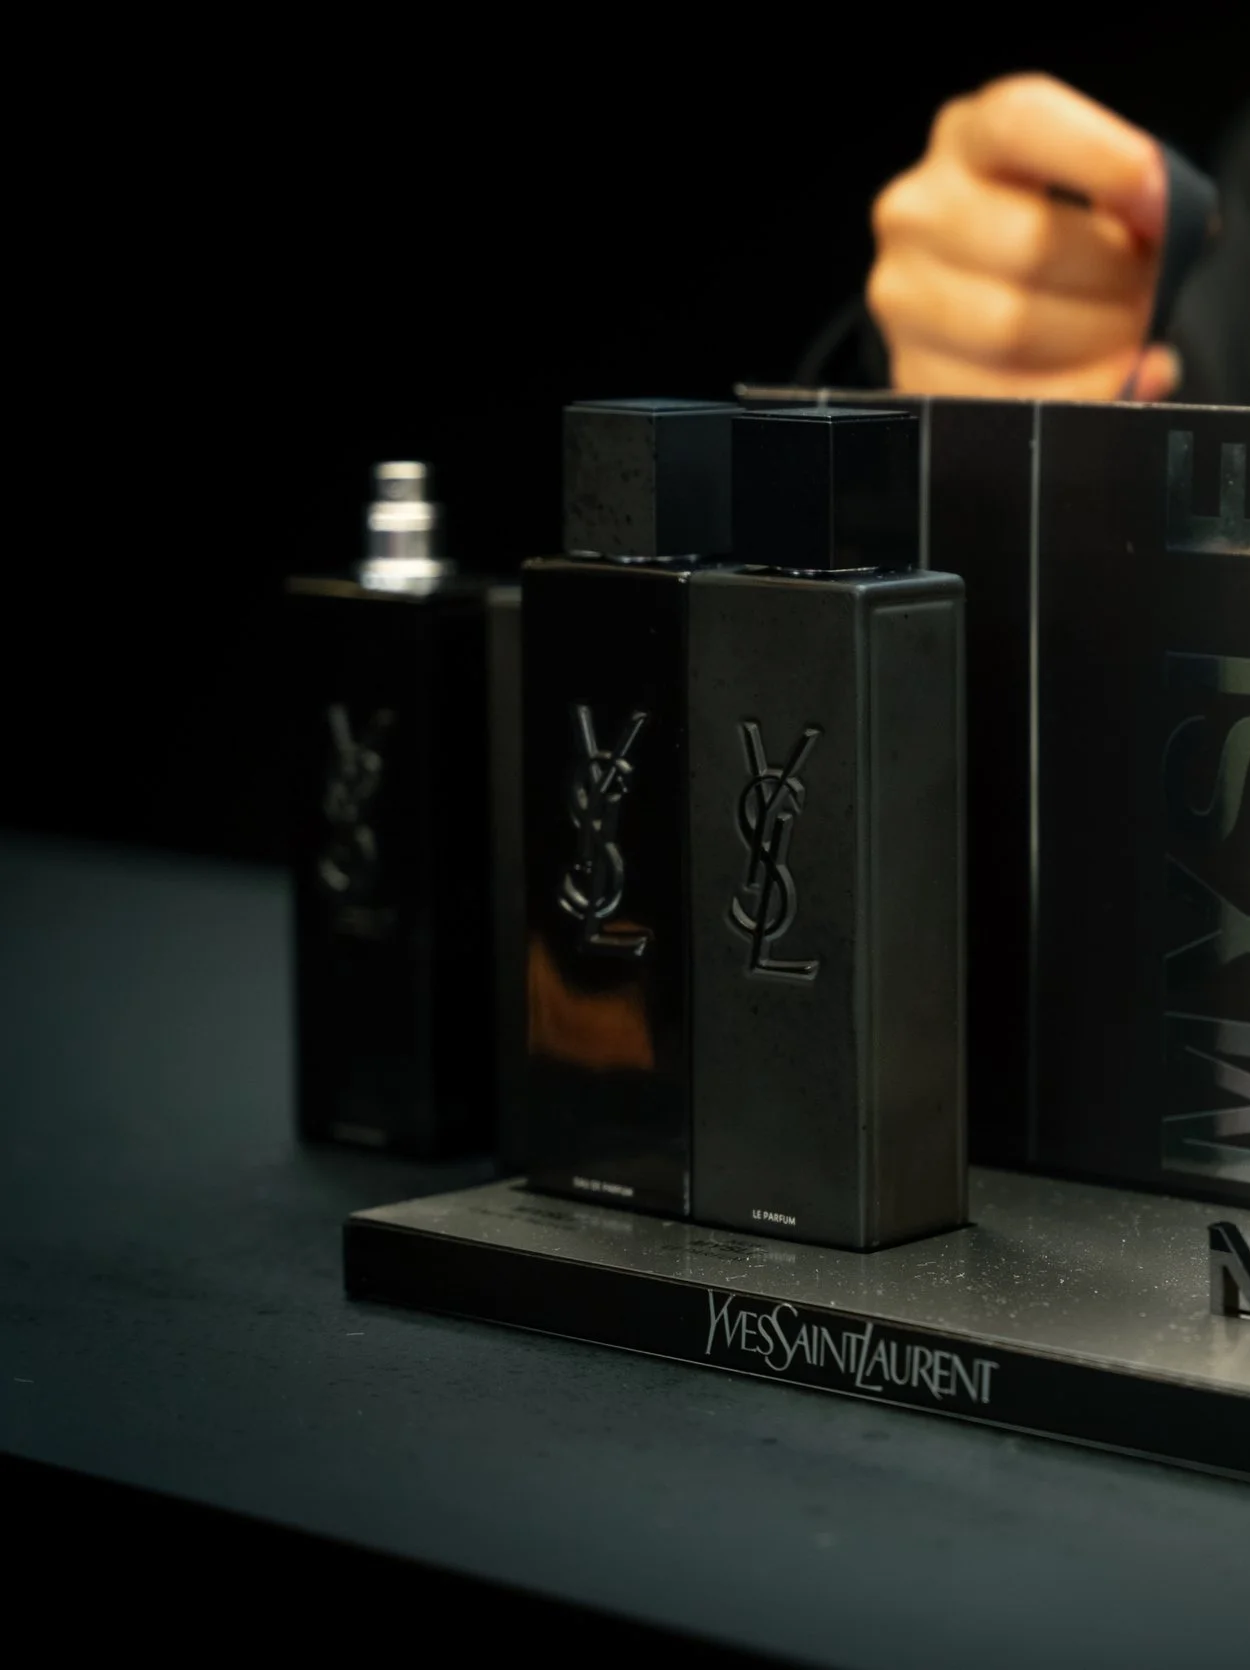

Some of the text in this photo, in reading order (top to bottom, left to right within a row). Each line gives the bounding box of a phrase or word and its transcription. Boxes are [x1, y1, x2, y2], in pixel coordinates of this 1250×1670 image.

[726, 718, 823, 981] YSL
[752, 1209, 796, 1226] LE PARFUM
